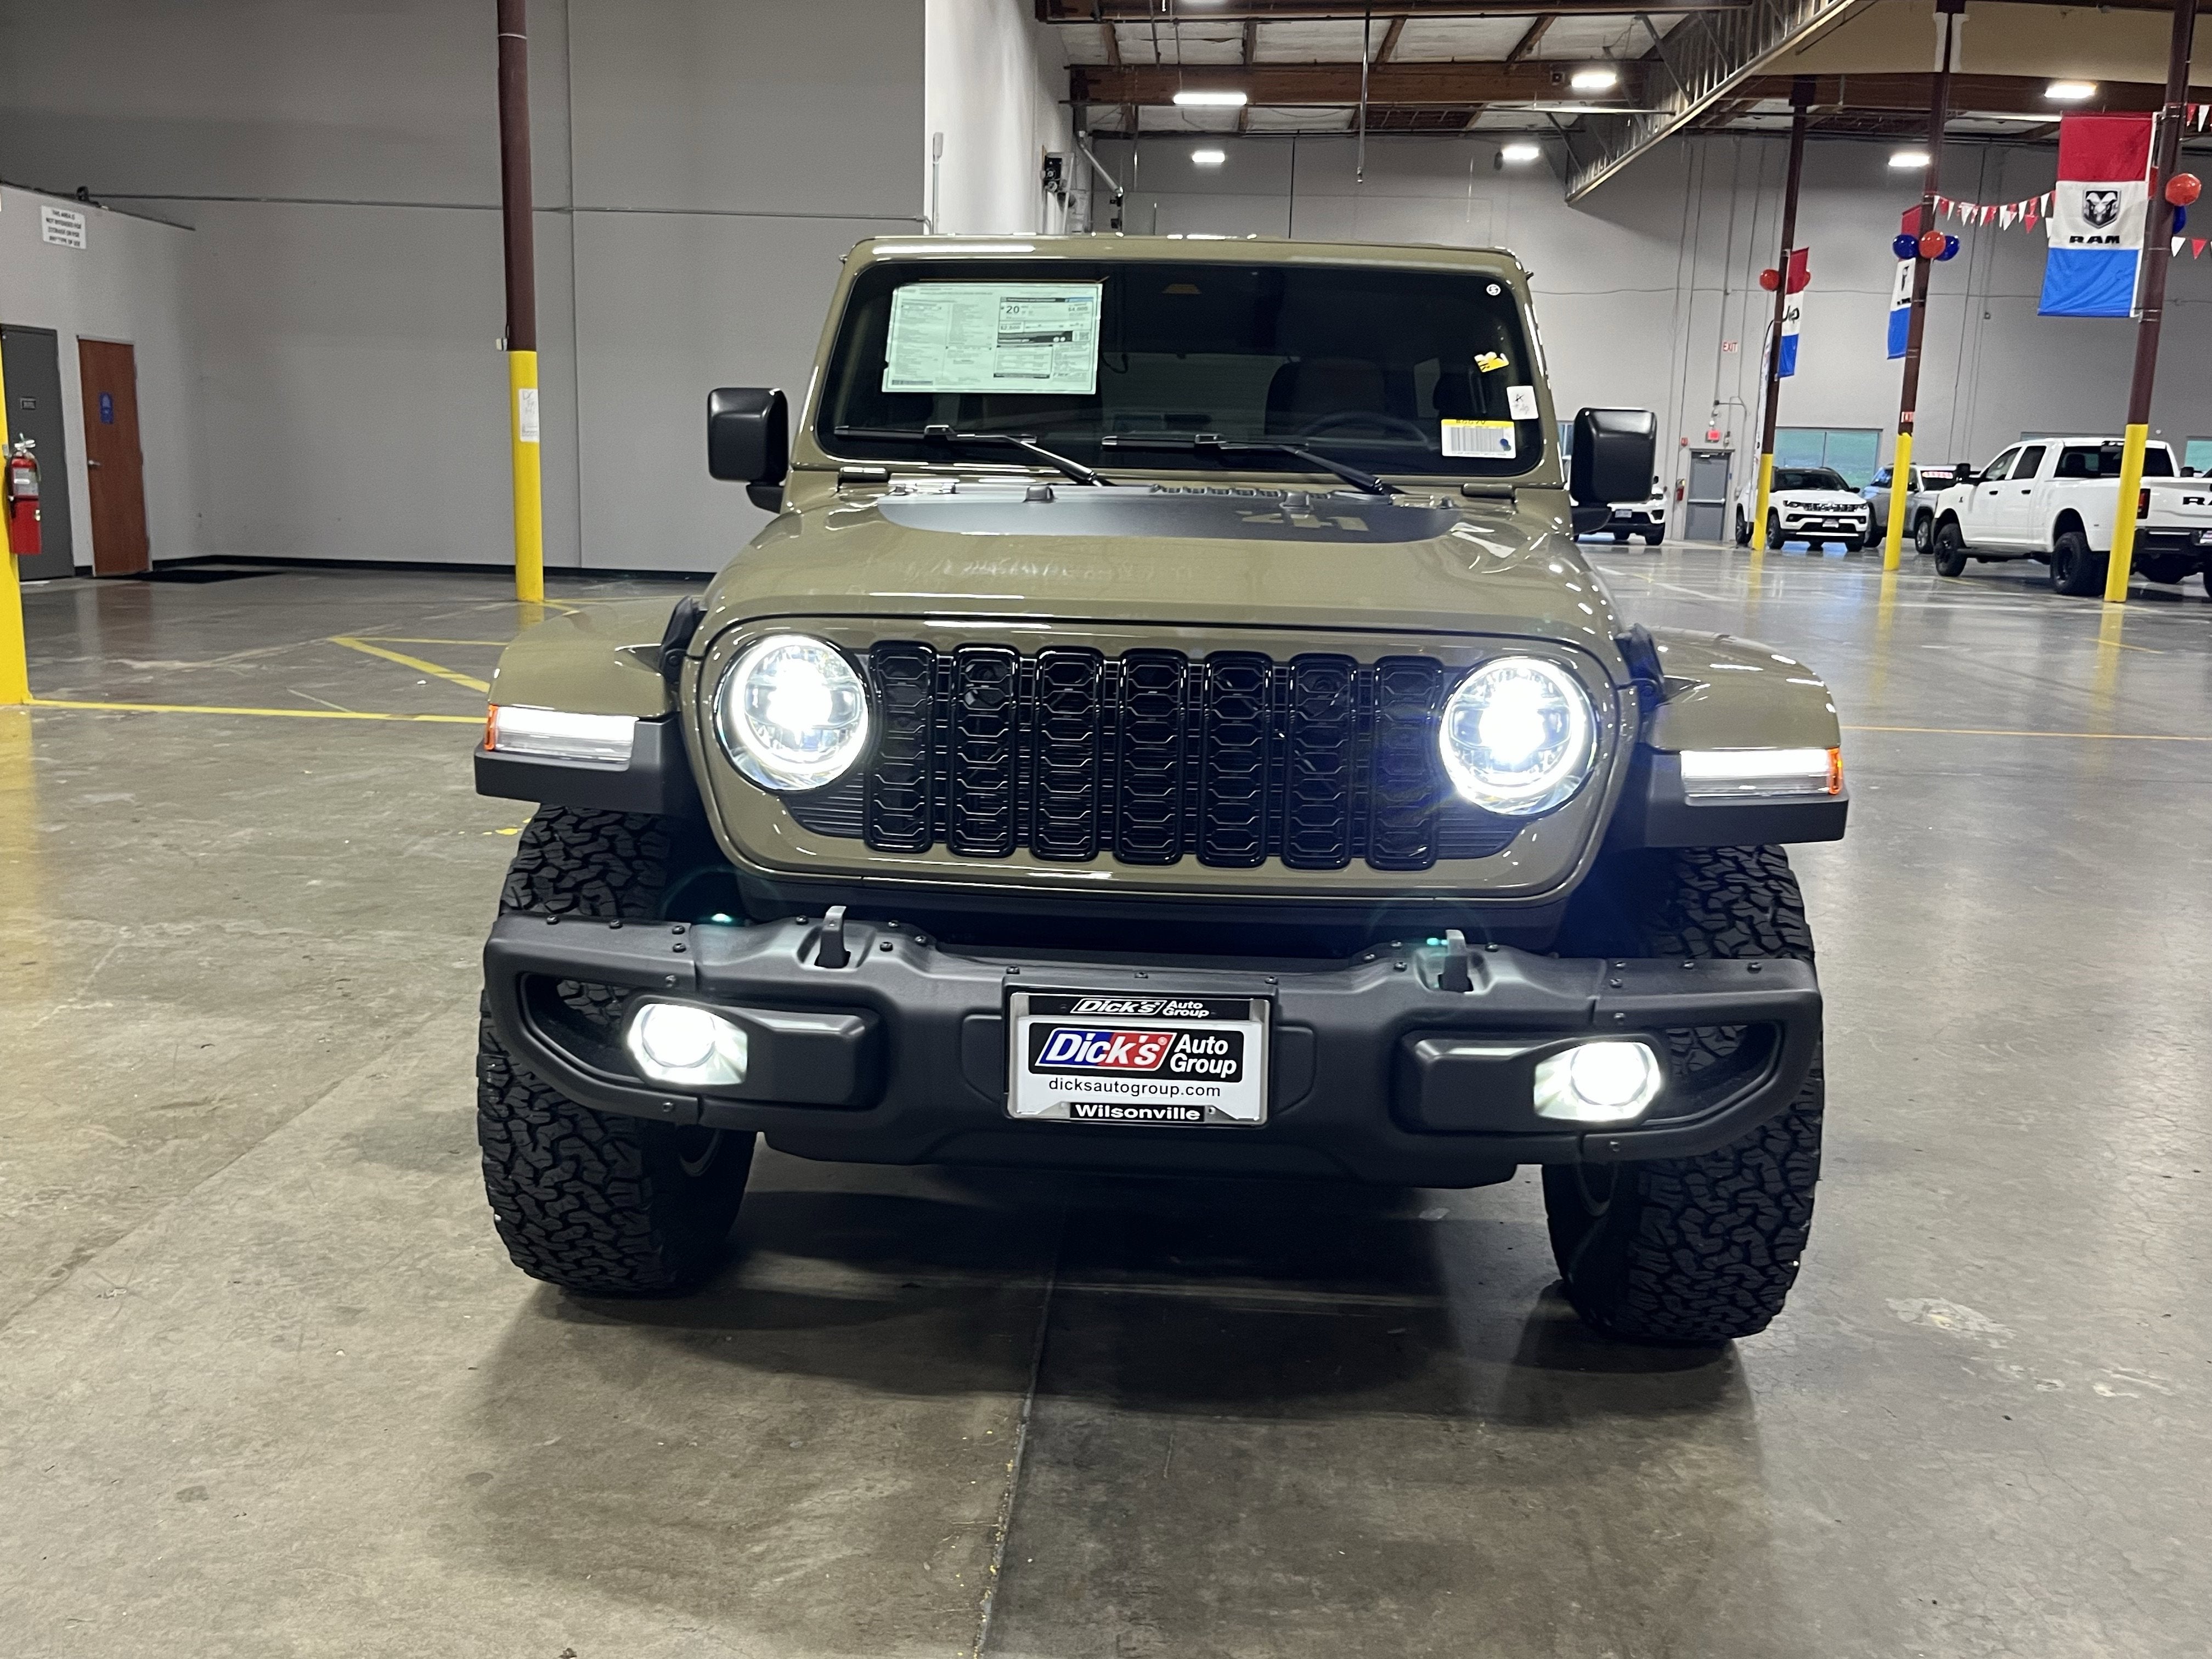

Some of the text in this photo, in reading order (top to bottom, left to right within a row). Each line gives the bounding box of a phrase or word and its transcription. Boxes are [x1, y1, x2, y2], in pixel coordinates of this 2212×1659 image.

[2069, 235, 2120, 244] RAM
[2183, 496, 2212, 505] R
[1162, 1007, 1210, 1018] Group
[1165, 1000, 1204, 1009] Auto
[1046, 1032, 1161, 1066] Dick's
[1174, 1034, 1229, 1055] Auto
[1170, 1053, 1237, 1079] Group
[1049, 1077, 1221, 1098] dicksautogroup.com
[1075, 1104, 1200, 1121] Wilsonville
